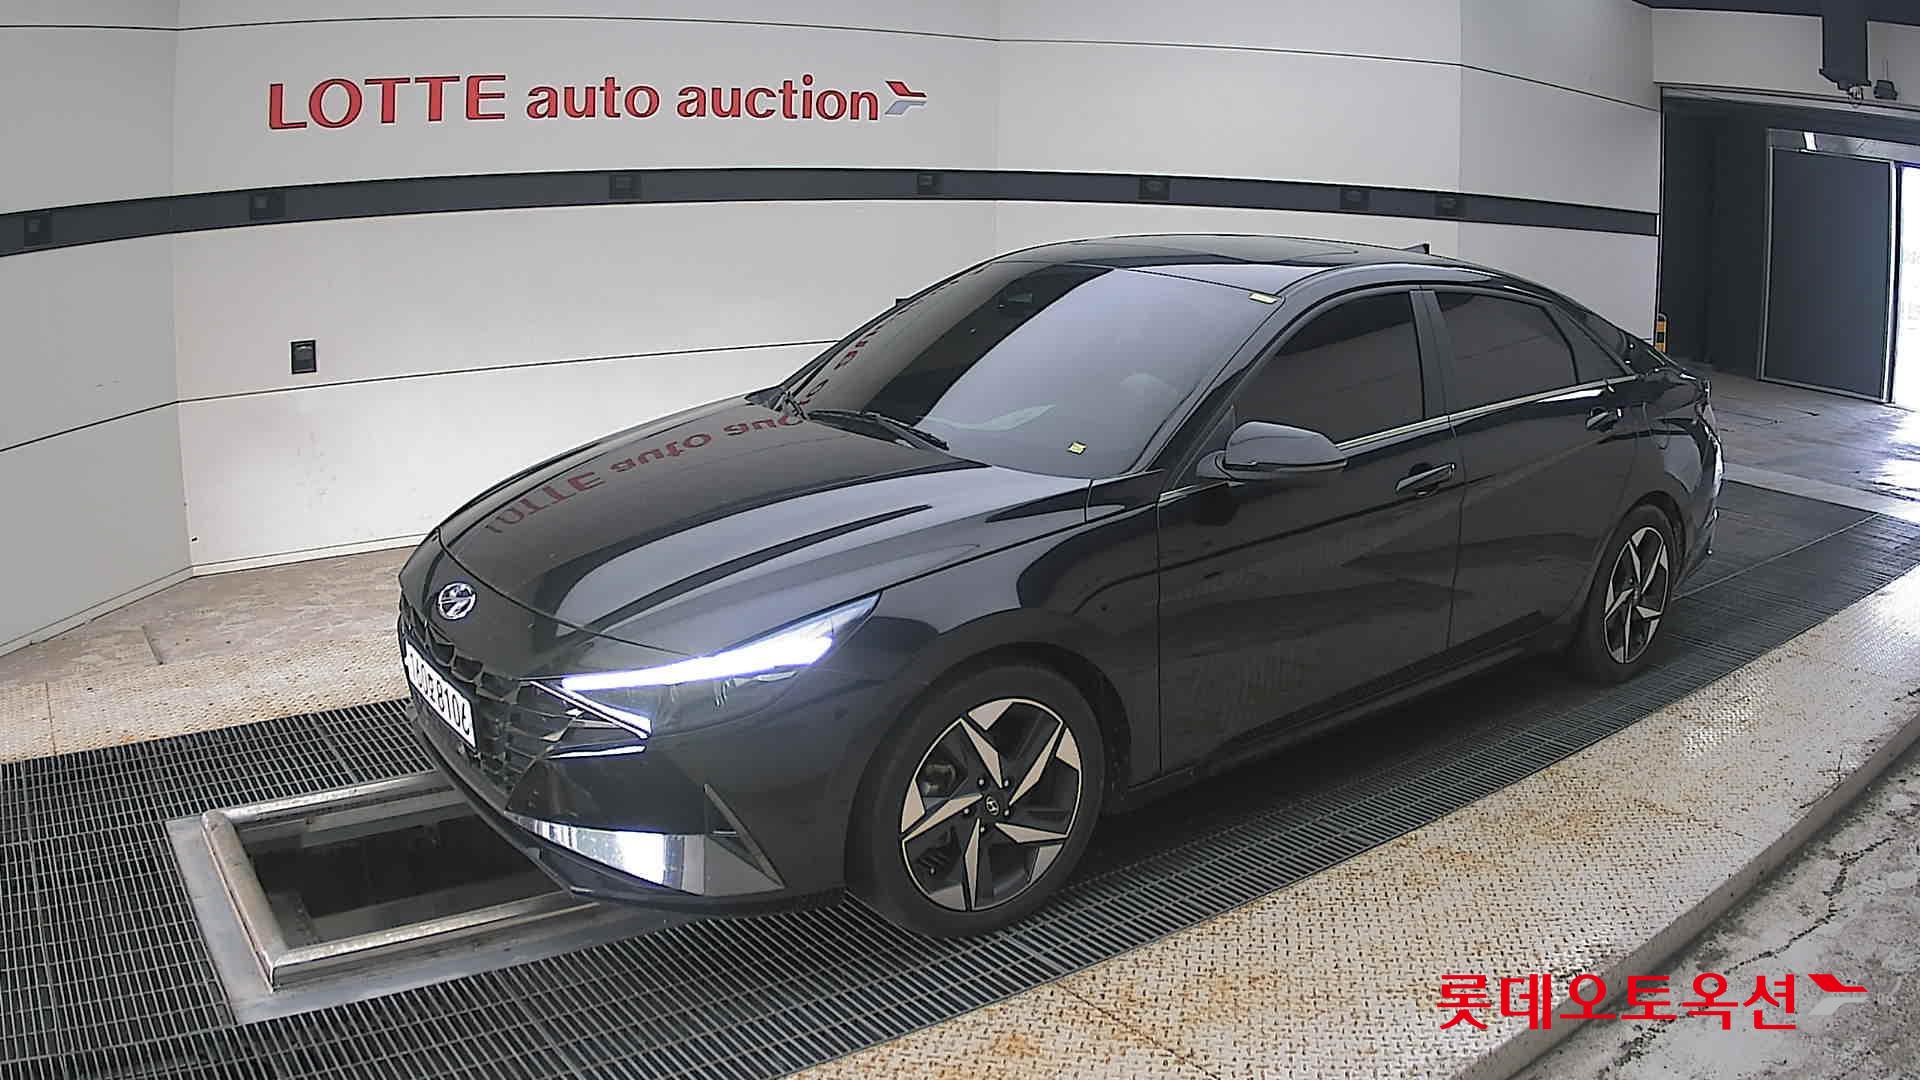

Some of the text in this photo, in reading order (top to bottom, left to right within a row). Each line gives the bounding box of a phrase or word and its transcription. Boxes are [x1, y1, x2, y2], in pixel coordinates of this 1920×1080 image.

[267, 73, 880, 131] LOTTE auto auction
